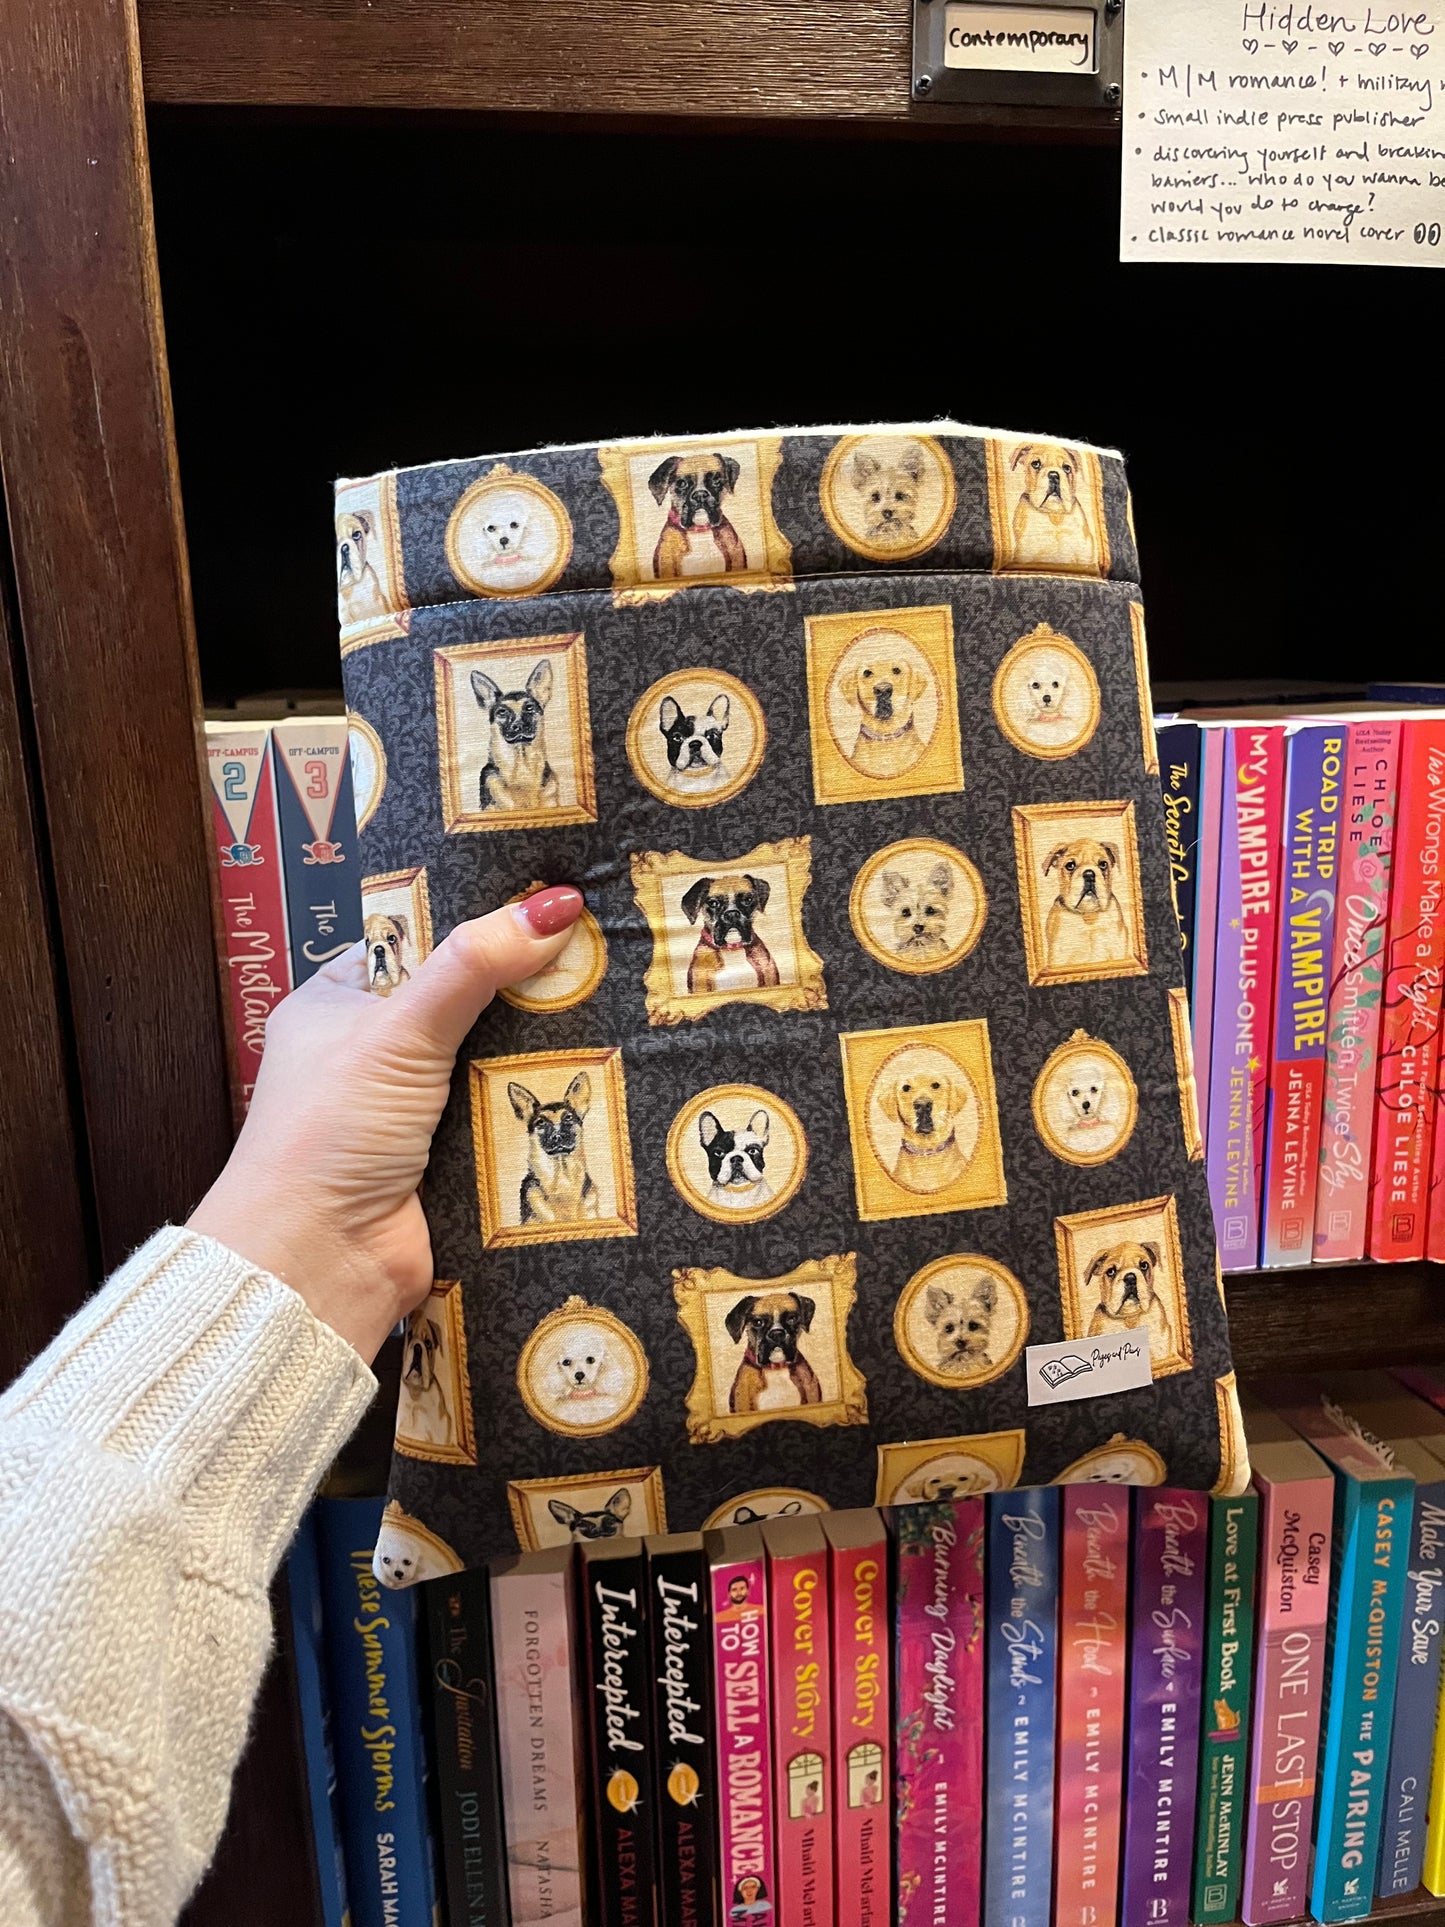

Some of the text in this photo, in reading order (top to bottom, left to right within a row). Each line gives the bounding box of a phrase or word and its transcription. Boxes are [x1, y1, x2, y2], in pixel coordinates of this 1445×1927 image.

[949, 27, 1089, 66] Contemporary
[1243, 2, 1436, 35] Hidden Love
[1217, 109, 1269, 126] indie
[1277, 112, 1323, 131] press
[1333, 110, 1426, 131] publisher
[1228, 66, 1327, 92] romance!
[1358, 73, 1432, 111] military
[1153, 146, 1248, 174] discovering
[1256, 145, 1327, 171] yourself
[1335, 142, 1370, 161] and
[1248, 169, 1288, 187] who
[1293, 167, 1314, 186] do
[1322, 173, 1355, 191] you
[1362, 172, 1422, 187] wanna
[1148, 225, 1406, 243] classic romance novel cover
[1151, 199, 1203, 214] would
[1211, 202, 1242, 222] you
[1251, 195, 1273, 210] do
[1281, 198, 1299, 211] to
[223, 761, 248, 801] 2
[289, 747, 340, 757] OFF-CAMPUS
[304, 760, 329, 799] 3
[1169, 762, 1188, 790] The
[1317, 738, 1342, 879] ROAD TRIP
[1350, 765, 1367, 842] LIESE
[1369, 759, 1388, 847] CHLOE
[1419, 786, 1445, 876] Wrongs
[228, 892, 256, 928] The
[309, 900, 338, 936] The
[1235, 734, 1271, 1056] MY VAMPIRE PLUS-ONE
[1289, 807, 1326, 1051] WITH A VAMPIRE
[1416, 880, 1441, 939] Make
[1416, 943, 1432, 957] a
[1398, 962, 1440, 1030] Right
[1321, 894, 1379, 1198] Once Smitten, Twice Shy
[1224, 1065, 1244, 1209] JENNA LEVINE
[1281, 1068, 1304, 1210] JENNA LEVINE
[1391, 1045, 1416, 1203] CHLOE LIESE
[1002, 1509, 1046, 1588] Beneath
[1154, 1499, 1198, 1577] Beneath
[1277, 1510, 1301, 1613] McQuiston
[1302, 1532, 1326, 1585] Casey
[1373, 1498, 1395, 1568] CASEY
[924, 1519, 957, 1623] Burning
[1010, 1597, 1024, 1618] the
[1084, 1589, 1100, 1610] the
[1161, 1585, 1176, 1606] the
[1220, 1507, 1244, 1692] Love at First Book
[1407, 1500, 1445, 1665] Make Your Save
[354, 1616, 390, 1719] Summer
[595, 1580, 644, 1751] Intercepted
[657, 1575, 705, 1744] Intercepted
[721, 1623, 740, 1651] TO
[740, 1610, 760, 1656] HOW
[790, 1568, 821, 1737] Cover Story
[851, 1560, 880, 1727] Cover Story
[1279, 1632, 1311, 1699] ONE
[524, 1610, 548, 1811] FORGOTTEN DREAMS
[724, 1660, 760, 1733] SELL
[923, 1627, 956, 1731] Daylight
[734, 1735, 754, 1748] A
[1013, 1716, 1029, 1781] EMILY
[1274, 1710, 1308, 1788] LAST
[1359, 1711, 1374, 1741] THE
[361, 1725, 396, 1812] Storms
[1082, 1708, 1101, 1889] EMILY MCINTIRE
[1153, 1703, 1177, 1882] EMILY MCINTIRE
[455, 1791, 480, 1839] JODI
[728, 1750, 764, 1875] ROMANCE
[1216, 1754, 1235, 1877] JENN McKINLAY
[1270, 1800, 1303, 1870] STOP
[1341, 1749, 1375, 1870] PAIRING
[1392, 1776, 1416, 1889] CALI MELLE
[377, 1832, 399, 1894] SARAH
[464, 1847, 485, 1908] ELLEN
[536, 1841, 554, 1921] NATASHA
[617, 1827, 637, 1890] ALEXA
[677, 1821, 696, 1883] ALEXA
[933, 1782, 947, 1925] EMILY MCINTIRE
[1011, 1794, 1028, 1899] MCINTIRE
